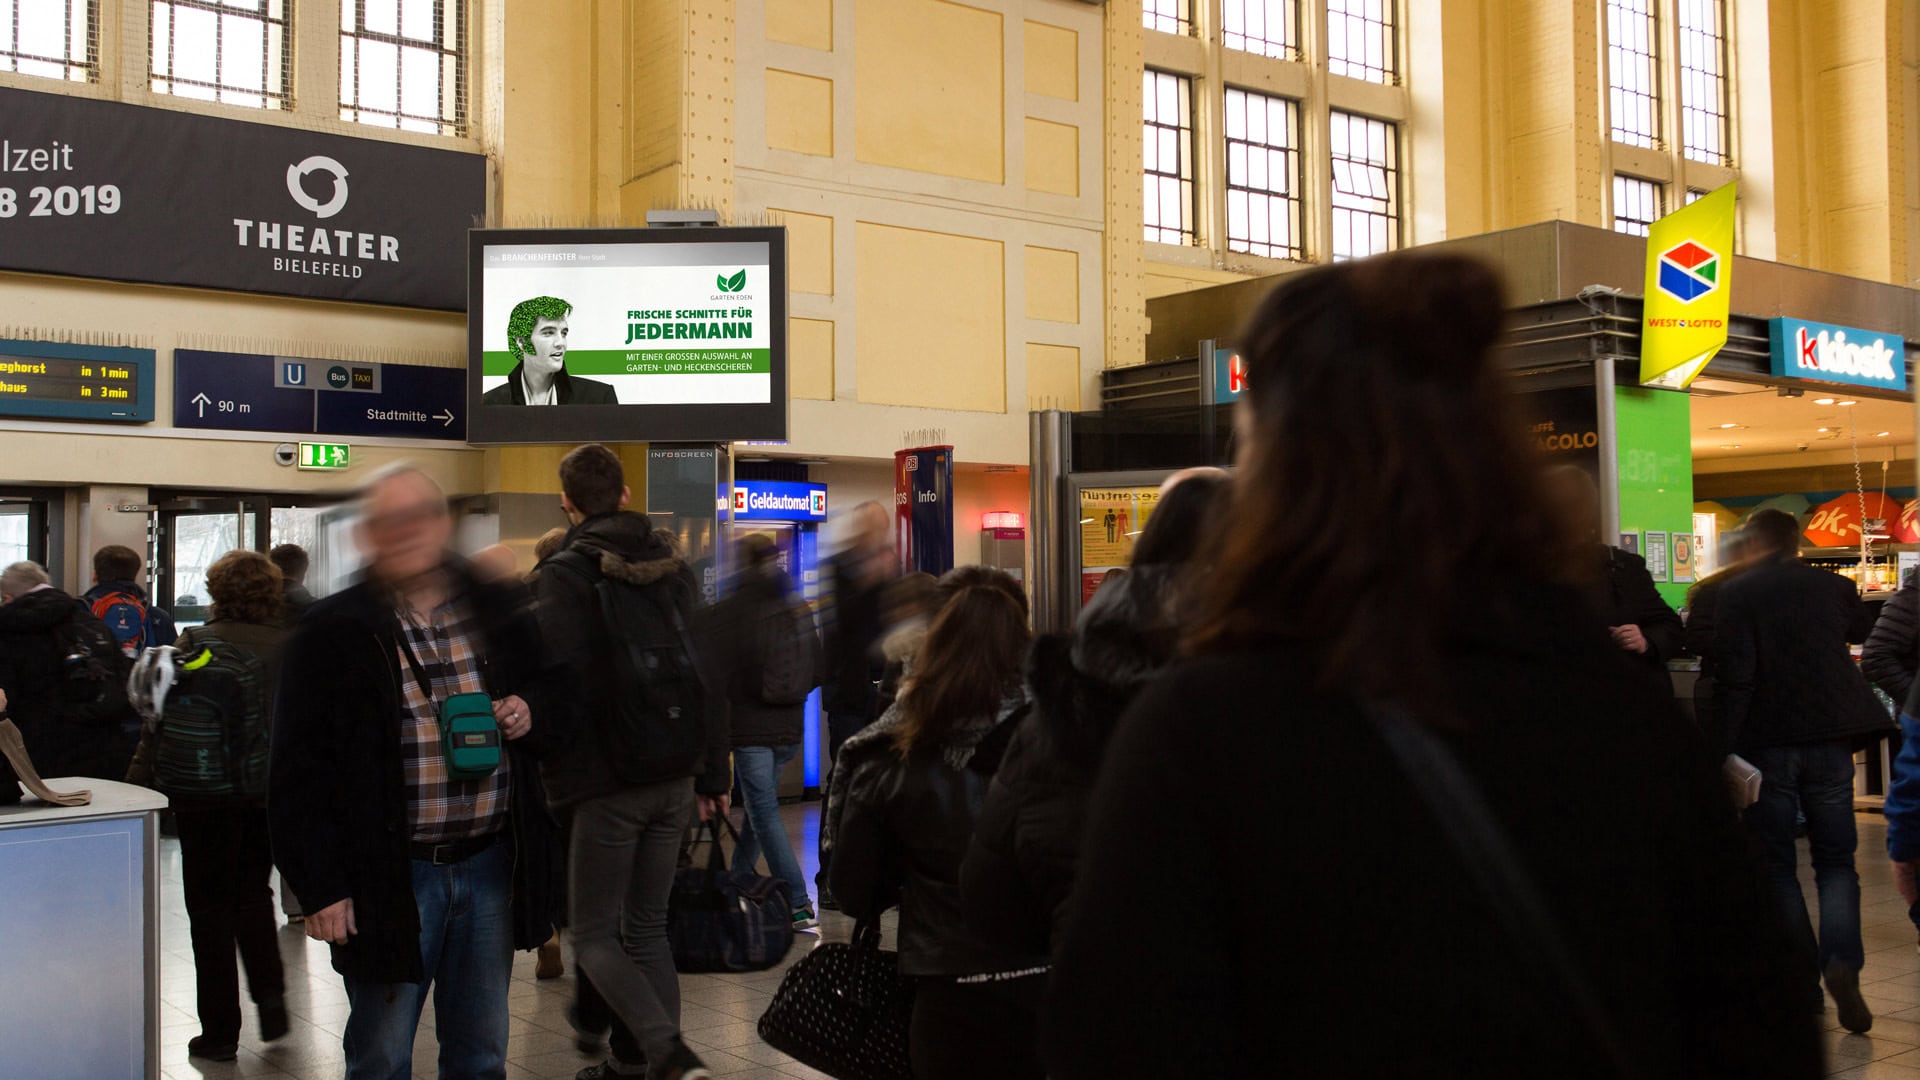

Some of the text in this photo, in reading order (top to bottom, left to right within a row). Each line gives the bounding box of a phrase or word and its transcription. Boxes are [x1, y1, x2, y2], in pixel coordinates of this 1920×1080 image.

[3, 140, 74, 172] lzeit
[0, 184, 121, 218] 8 2019
[233, 218, 400, 262] THEATER
[502, 253, 577, 262] BRANCHENFENSTER
[273, 257, 362, 279] BIELEFELD
[627, 306, 753, 319] FRISCHE SCHNITTE FÜR
[1648, 318, 1723, 328] WEST LOTTO
[625, 322, 753, 345] JEDERMANN
[626, 352, 753, 361] MIT EINER GROSSEN AUSWAHL AN
[0, 361, 129, 379] eghorst in 1 min
[626, 364, 662, 372] GARTEN-
[684, 363, 753, 371] HECKENSCHEREN
[286, 365, 302, 385] U
[331, 372, 346, 381] Bus
[354, 373, 371, 383] TAXI
[0, 381, 128, 399] haus in 3 min
[218, 401, 251, 413] 90 m
[367, 408, 427, 422] Stadtmitte
[750, 491, 810, 512] Geldautomat
[918, 490, 937, 503] Info
